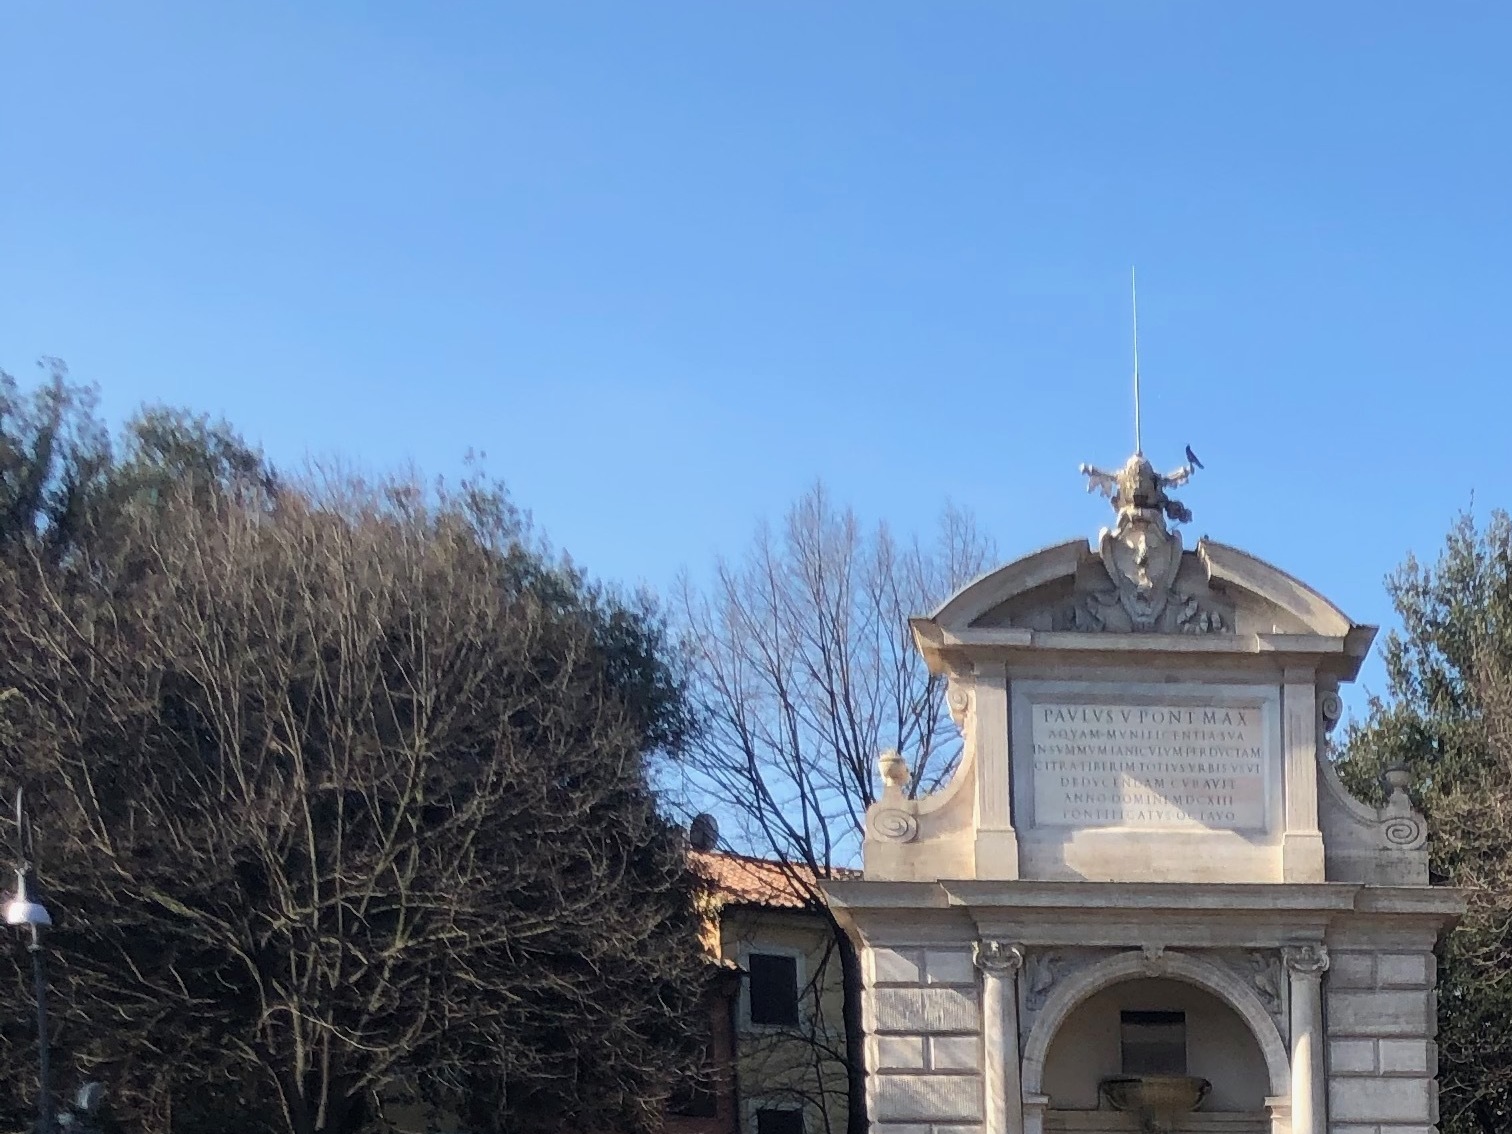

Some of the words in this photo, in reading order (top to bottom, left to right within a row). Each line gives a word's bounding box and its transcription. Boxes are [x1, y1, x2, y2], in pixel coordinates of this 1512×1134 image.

[1120, 709, 1132, 724] V
[1140, 710, 1196, 725] PONT
[1202, 710, 1247, 726] MAX
[1220, 731, 1245, 742] SVA
